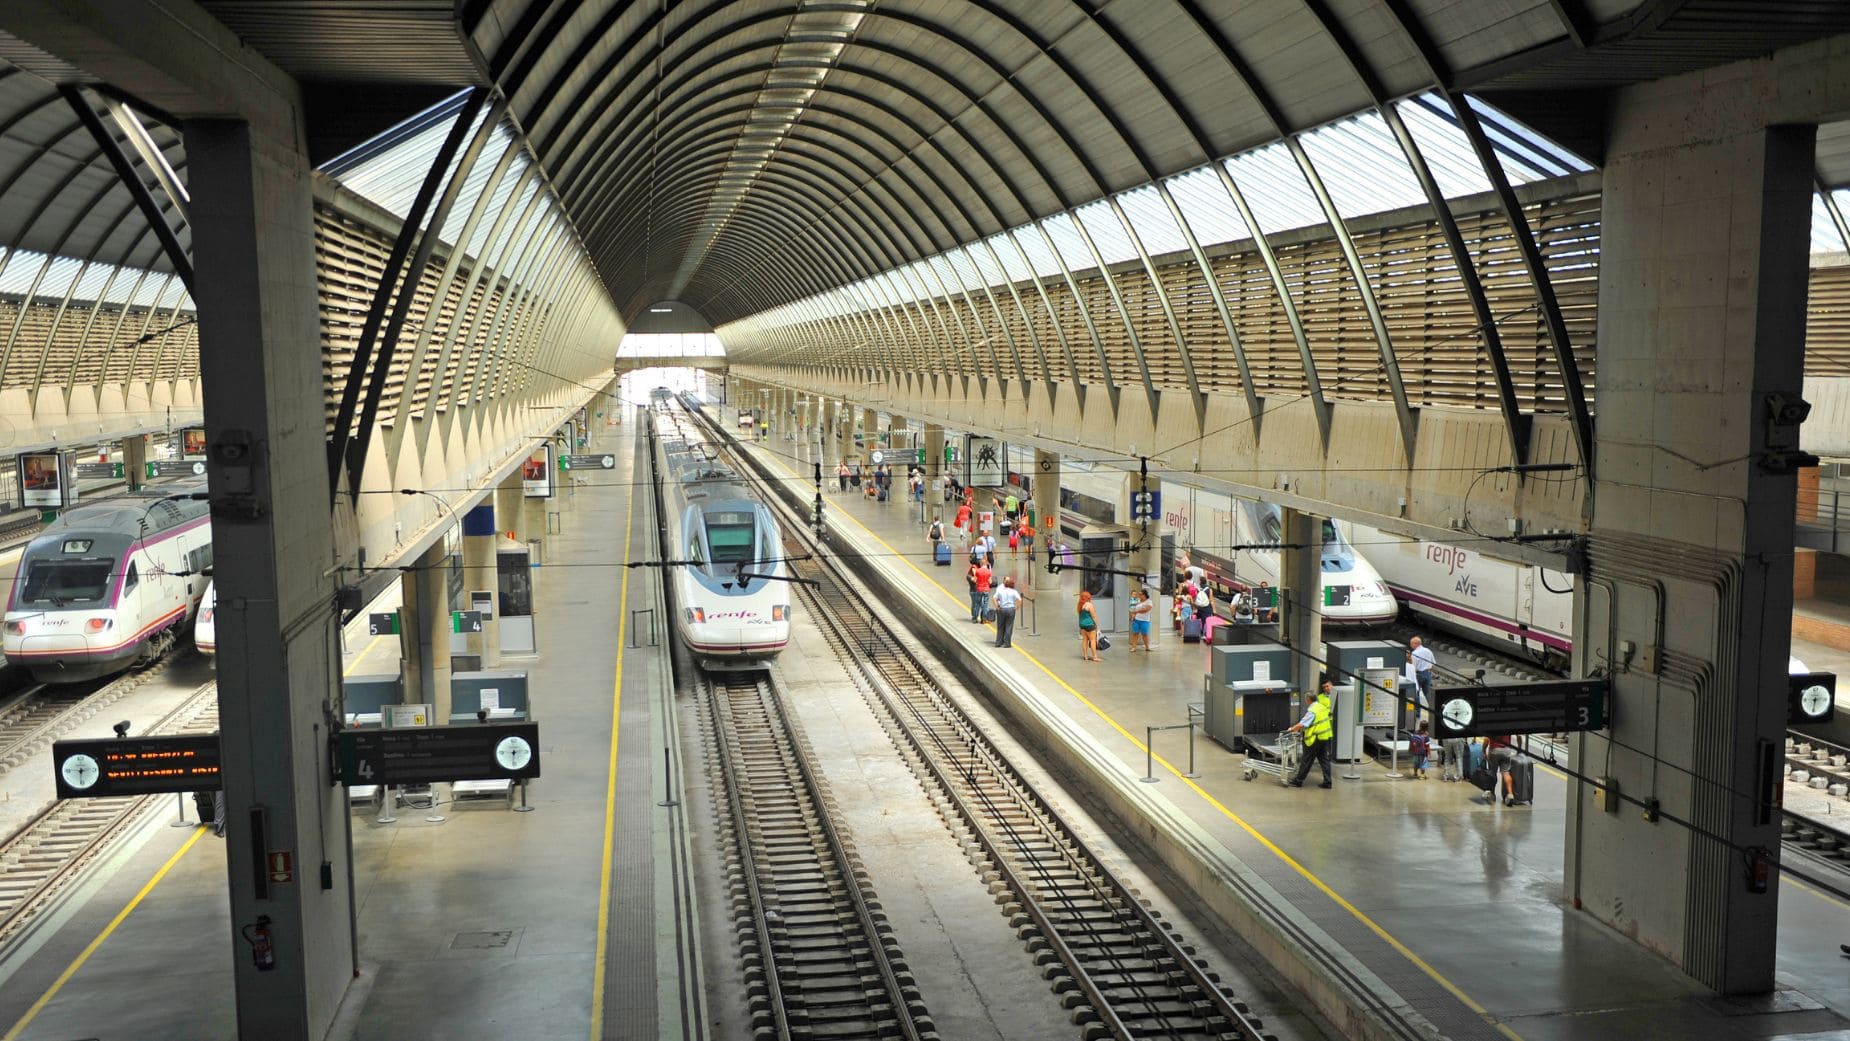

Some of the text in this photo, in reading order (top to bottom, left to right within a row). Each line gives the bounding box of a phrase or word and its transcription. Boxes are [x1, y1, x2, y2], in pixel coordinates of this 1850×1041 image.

[1165, 507, 1188, 536] renfe
[1426, 544, 1467, 576] renfe
[146, 556, 165, 586] renfe
[1454, 574, 1478, 598] AVE
[1253, 597, 1259, 607] 3
[1343, 595, 1350, 605] 2
[42, 619, 70, 627] renfe
[708, 610, 758, 620] renfe
[370, 623, 378, 635] 5
[472, 621, 480, 631] 4
[1578, 706, 1589, 726] 3
[358, 759, 375, 780] 4
